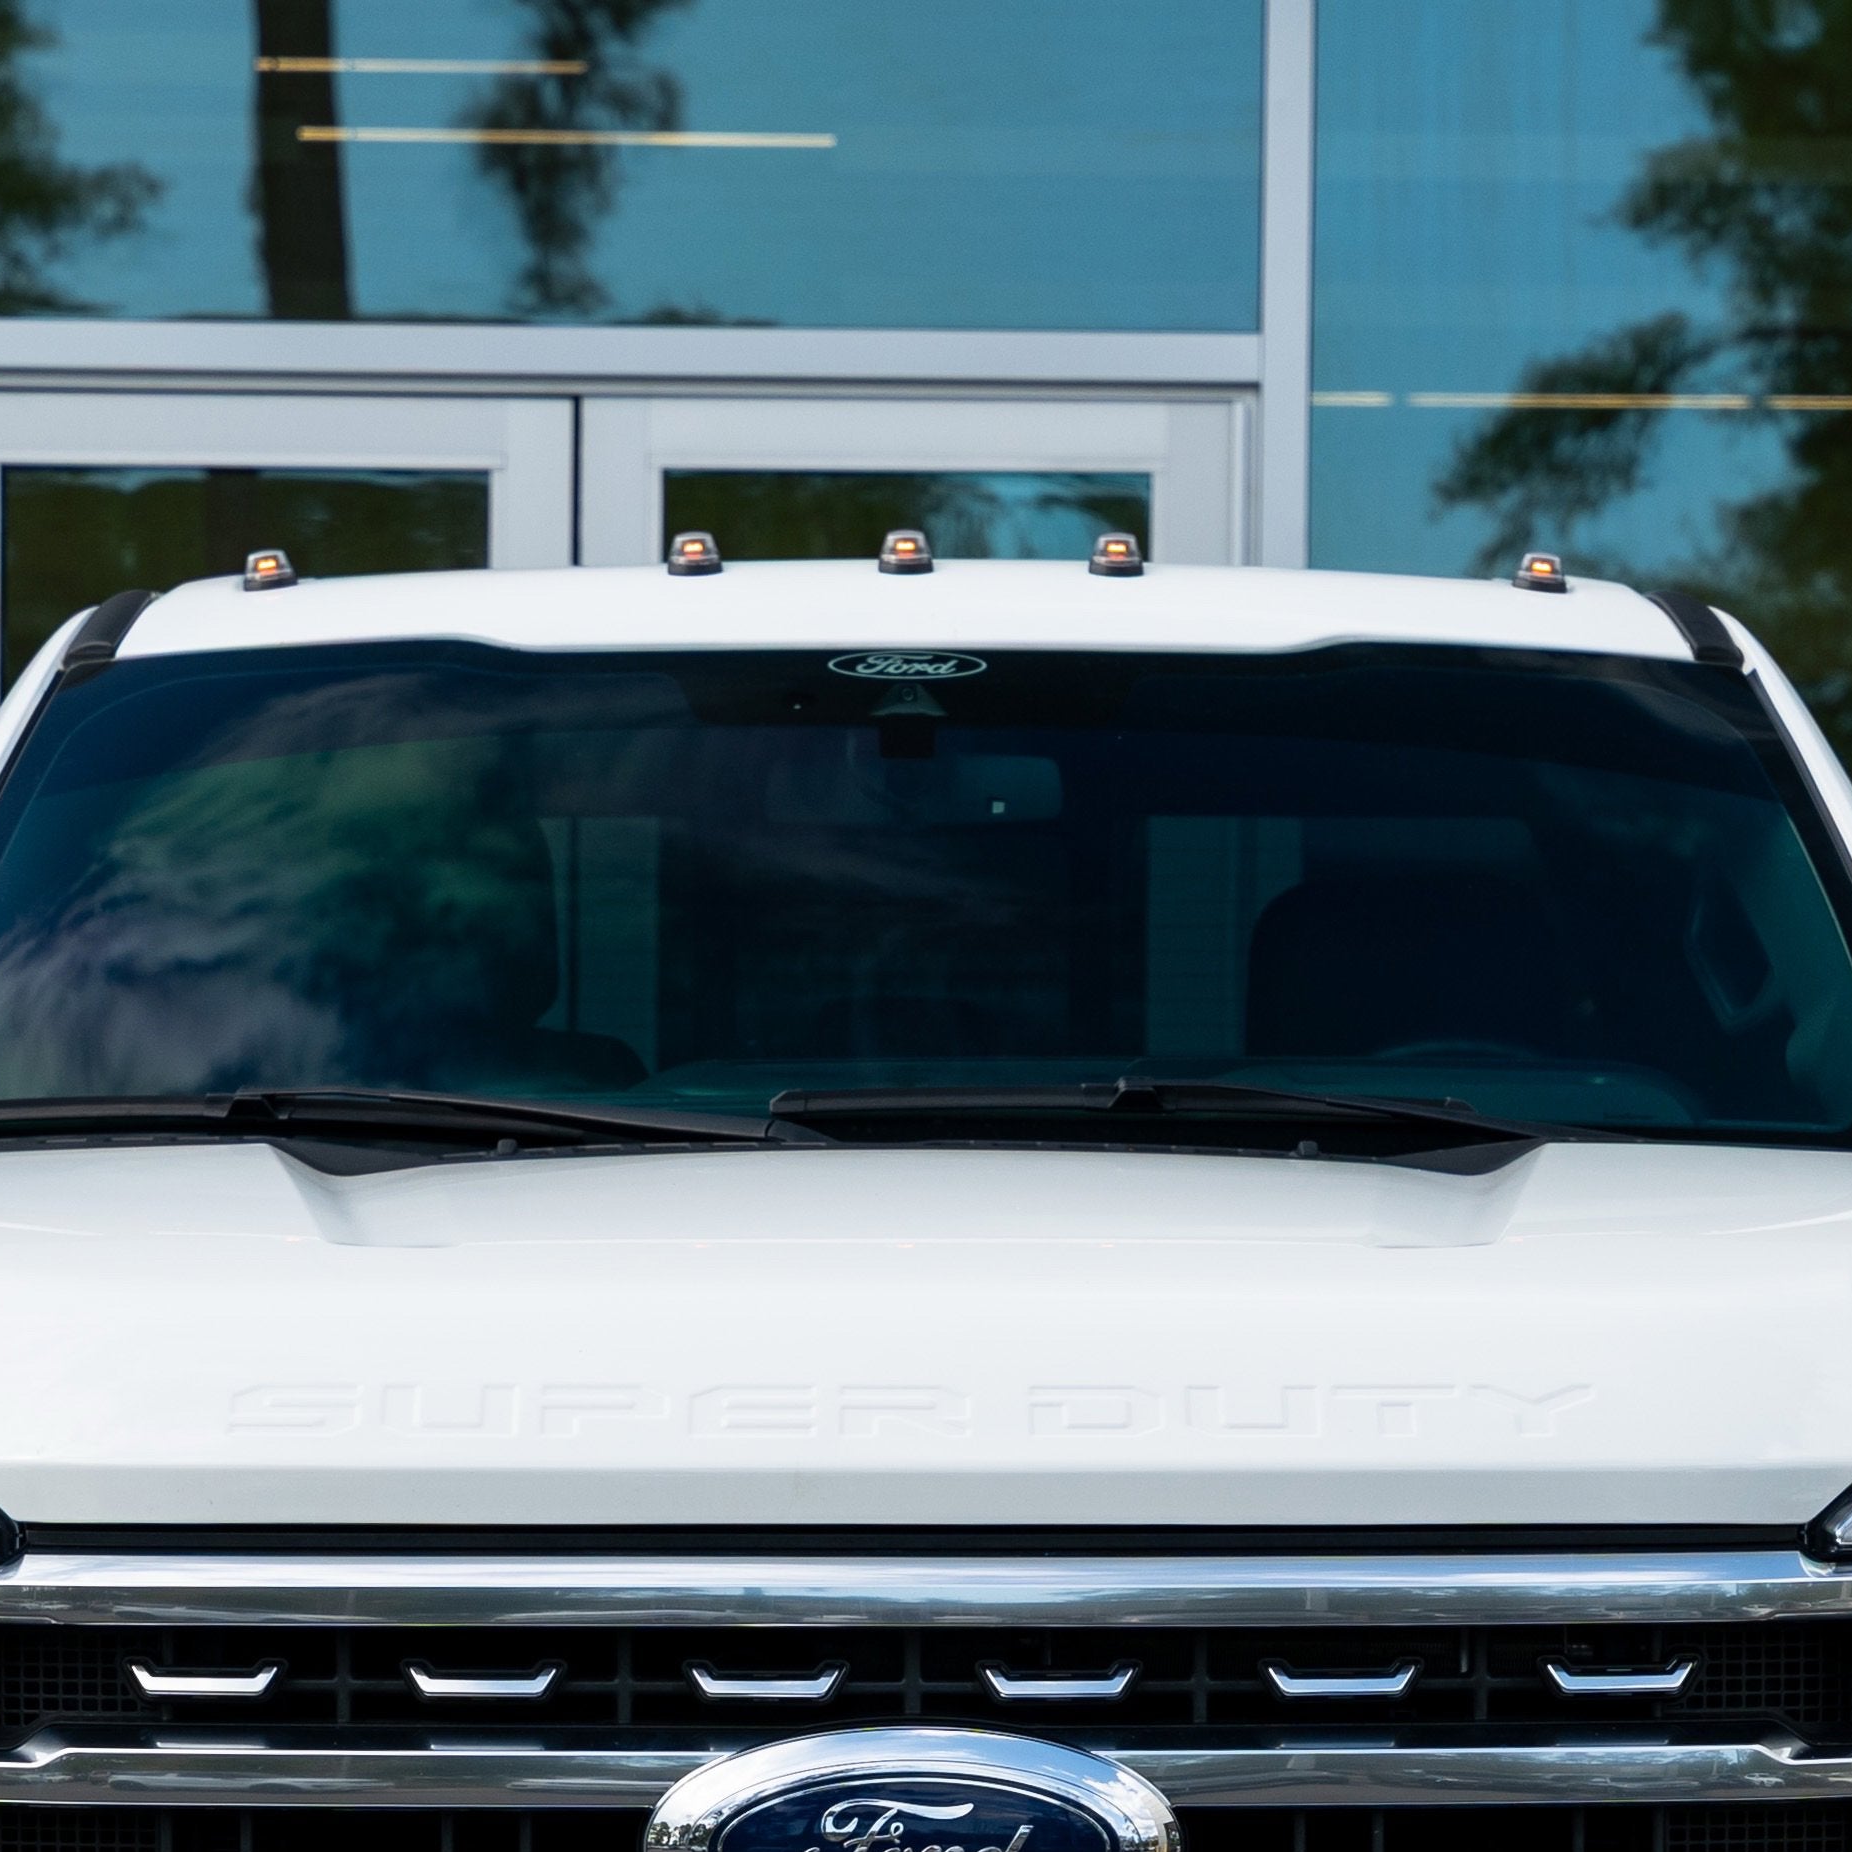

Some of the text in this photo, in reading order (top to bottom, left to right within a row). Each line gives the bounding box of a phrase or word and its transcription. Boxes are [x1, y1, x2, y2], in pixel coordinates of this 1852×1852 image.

[854, 653, 960, 675] Ford
[223, 1381, 1598, 1440] SUPER DUTY
